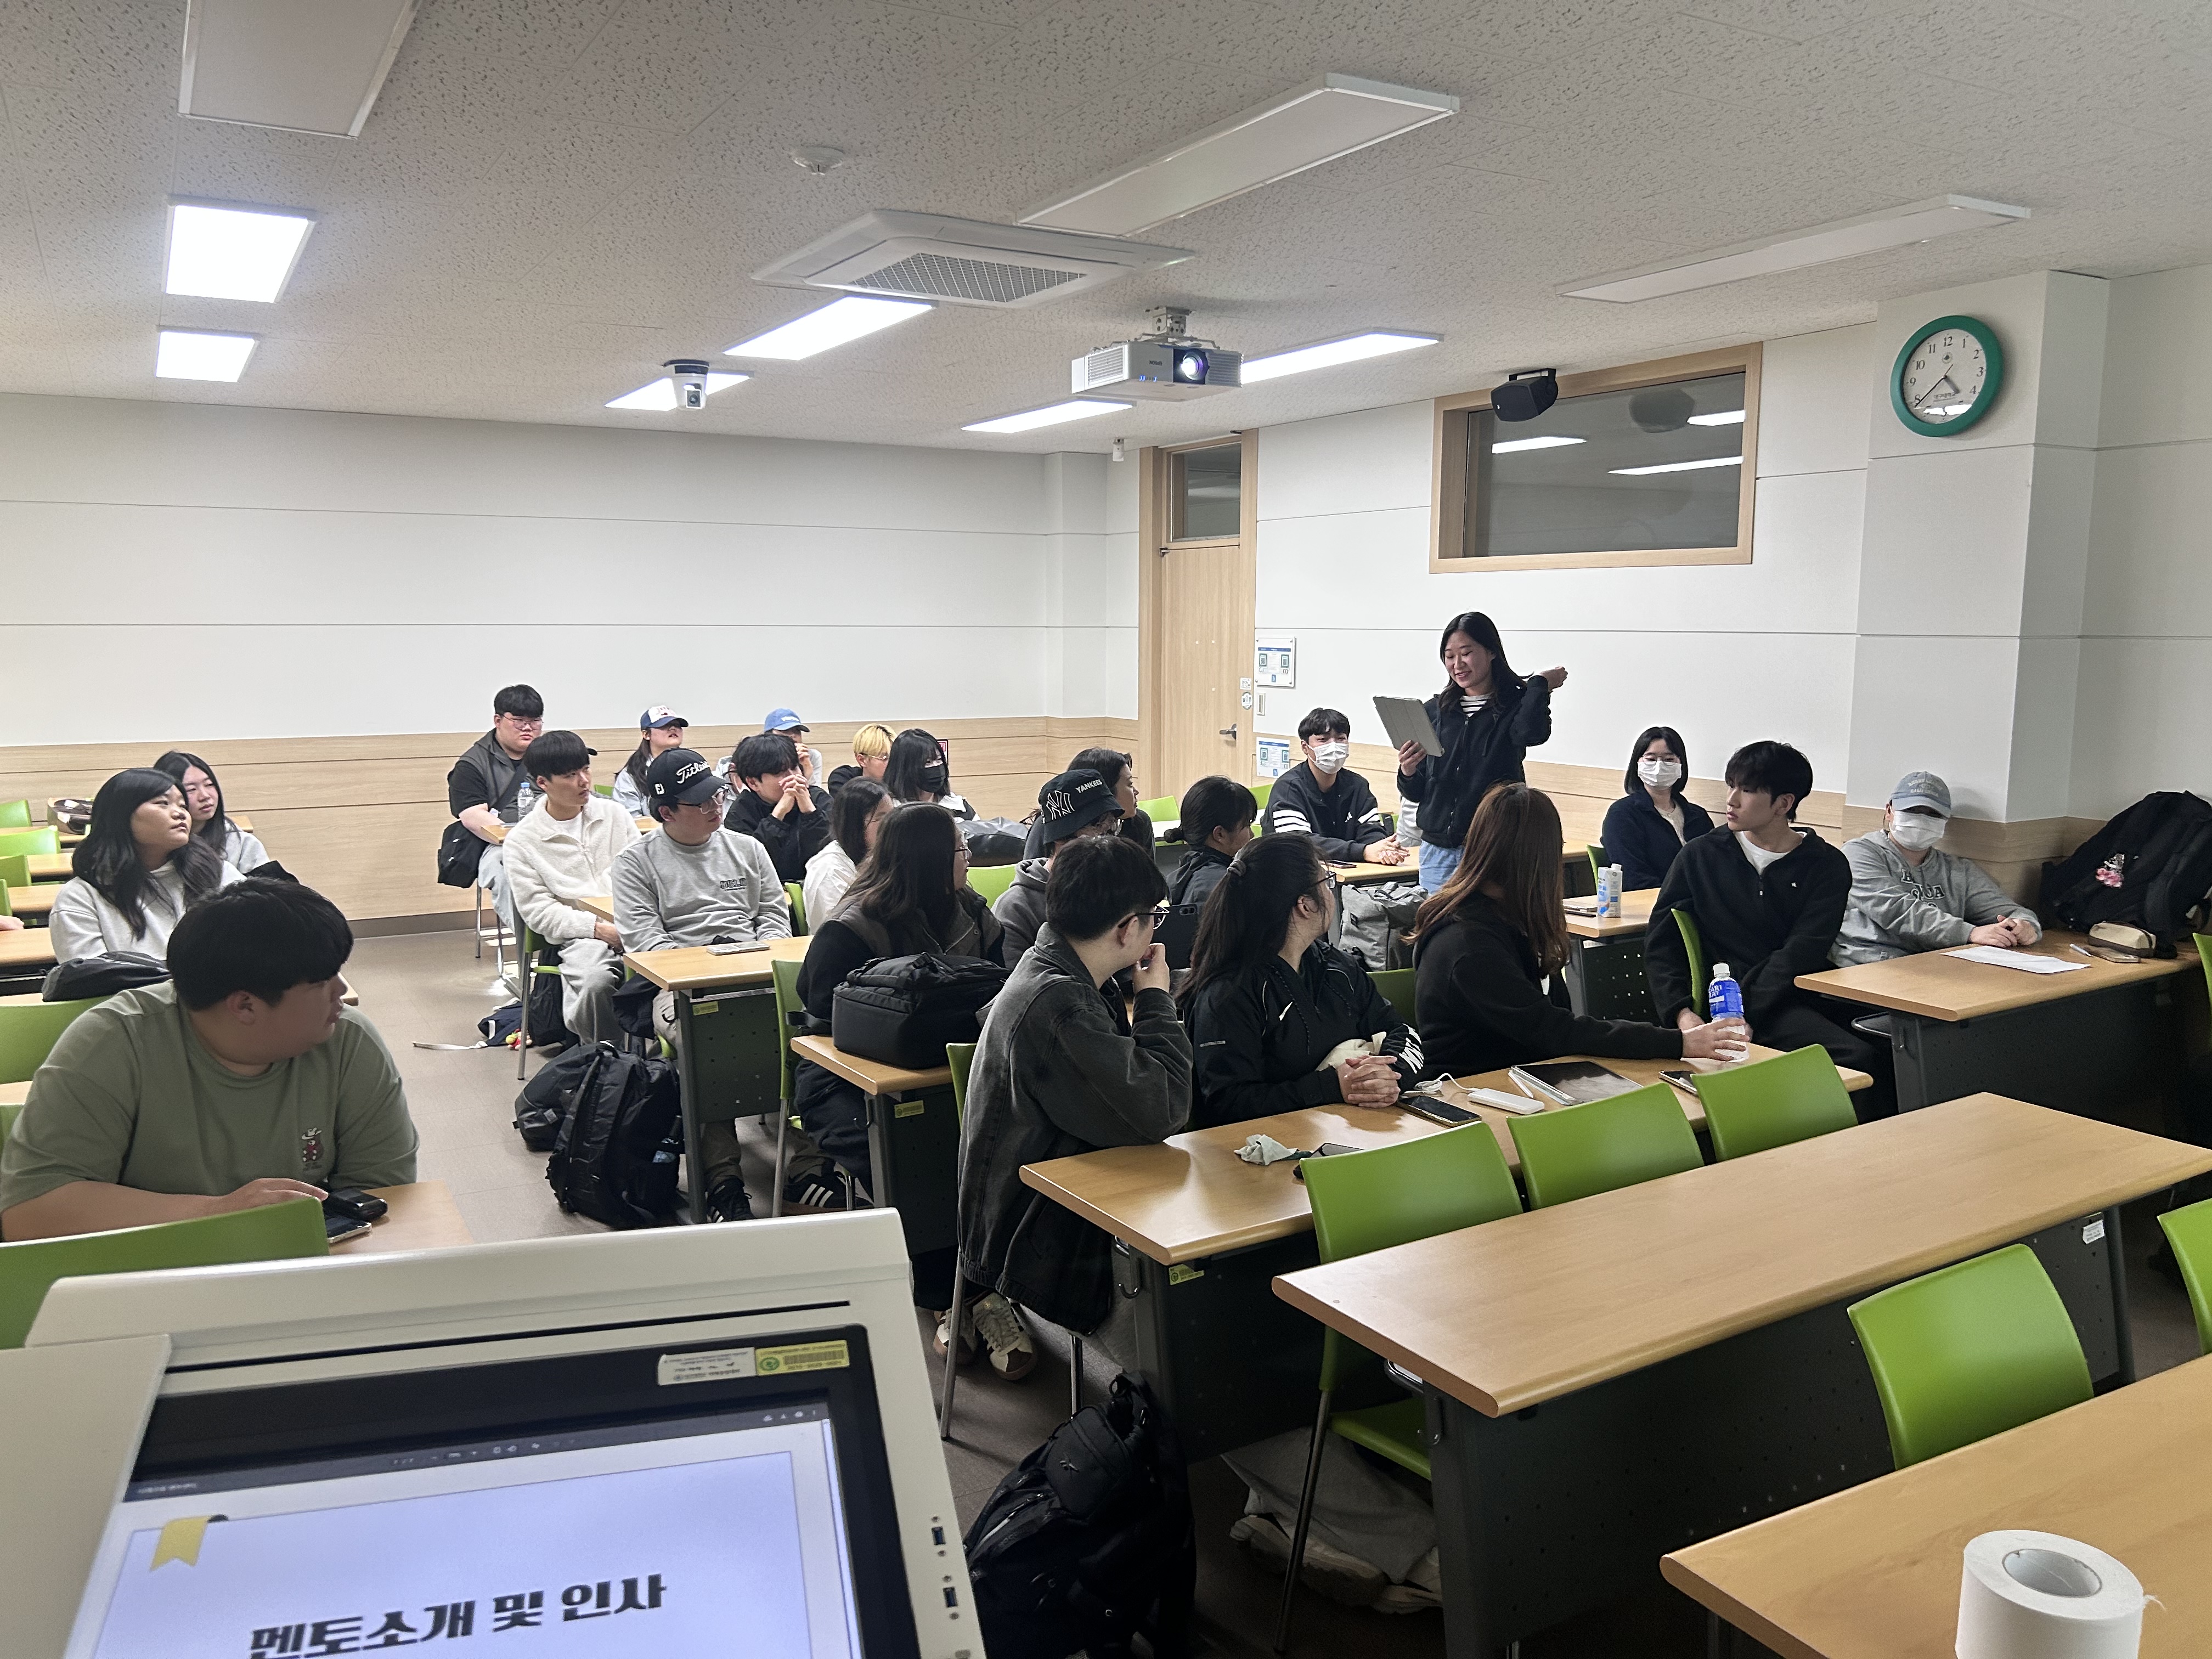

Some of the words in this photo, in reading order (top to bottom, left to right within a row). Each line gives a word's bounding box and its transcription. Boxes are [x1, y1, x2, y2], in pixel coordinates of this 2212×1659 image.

[1944, 336, 1953, 347] 12
[1962, 338, 1966, 348] 1
[1928, 343, 1936, 354] 11
[1973, 349, 1979, 359] 2
[1916, 360, 1925, 370] 10
[1976, 366, 1984, 377] 3
[1909, 377, 1916, 387] 9
[1970, 385, 1977, 394] 4
[1075, 779, 1103, 793] YANKEES
[250, 1600, 476, 1659] 멘토소개
[493, 1590, 545, 1633] 및
[561, 1573, 667, 1623] 인사
